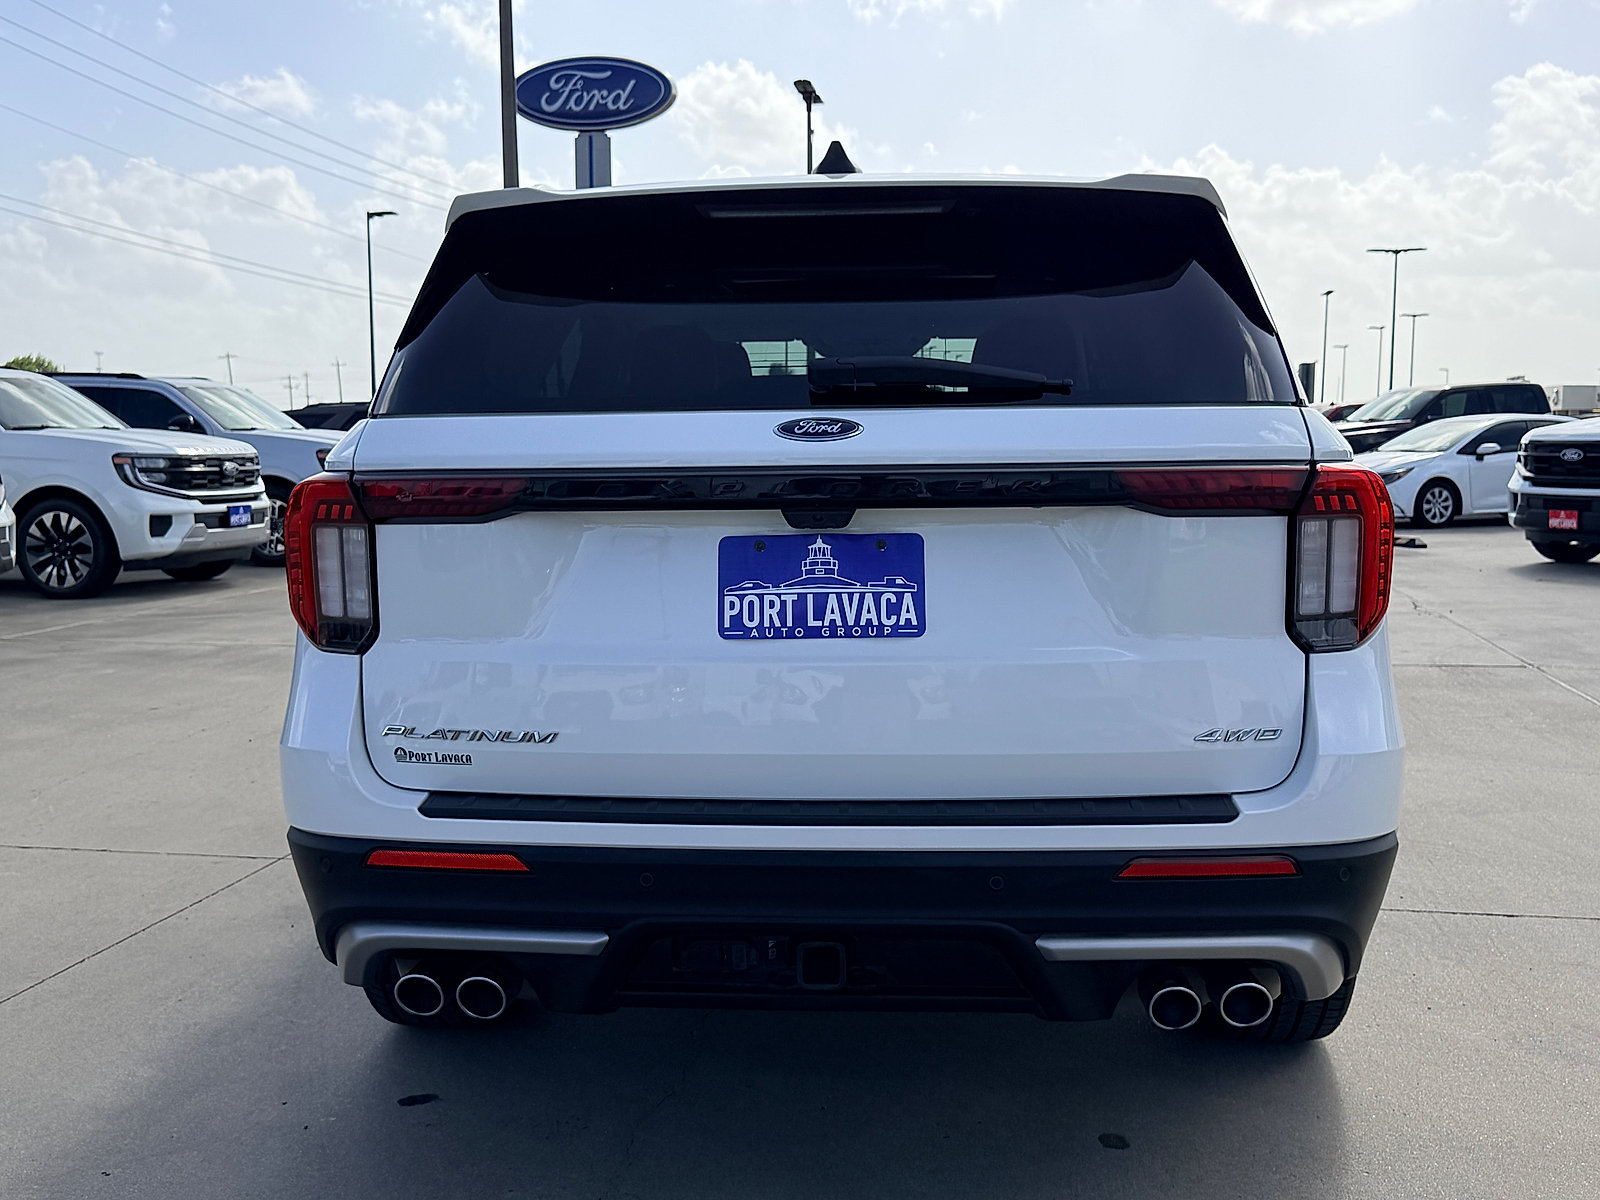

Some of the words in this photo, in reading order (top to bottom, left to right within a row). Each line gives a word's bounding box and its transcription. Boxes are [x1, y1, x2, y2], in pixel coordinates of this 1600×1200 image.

[540, 70, 636, 112] Ford
[794, 419, 842, 433] Ford
[724, 594, 798, 628] PORT
[807, 592, 918, 626] LAVACA
[750, 627, 804, 638] AUTO
[821, 626, 892, 637] GROUP
[381, 724, 560, 744] PLATINUM
[1193, 727, 1283, 743] 4WD
